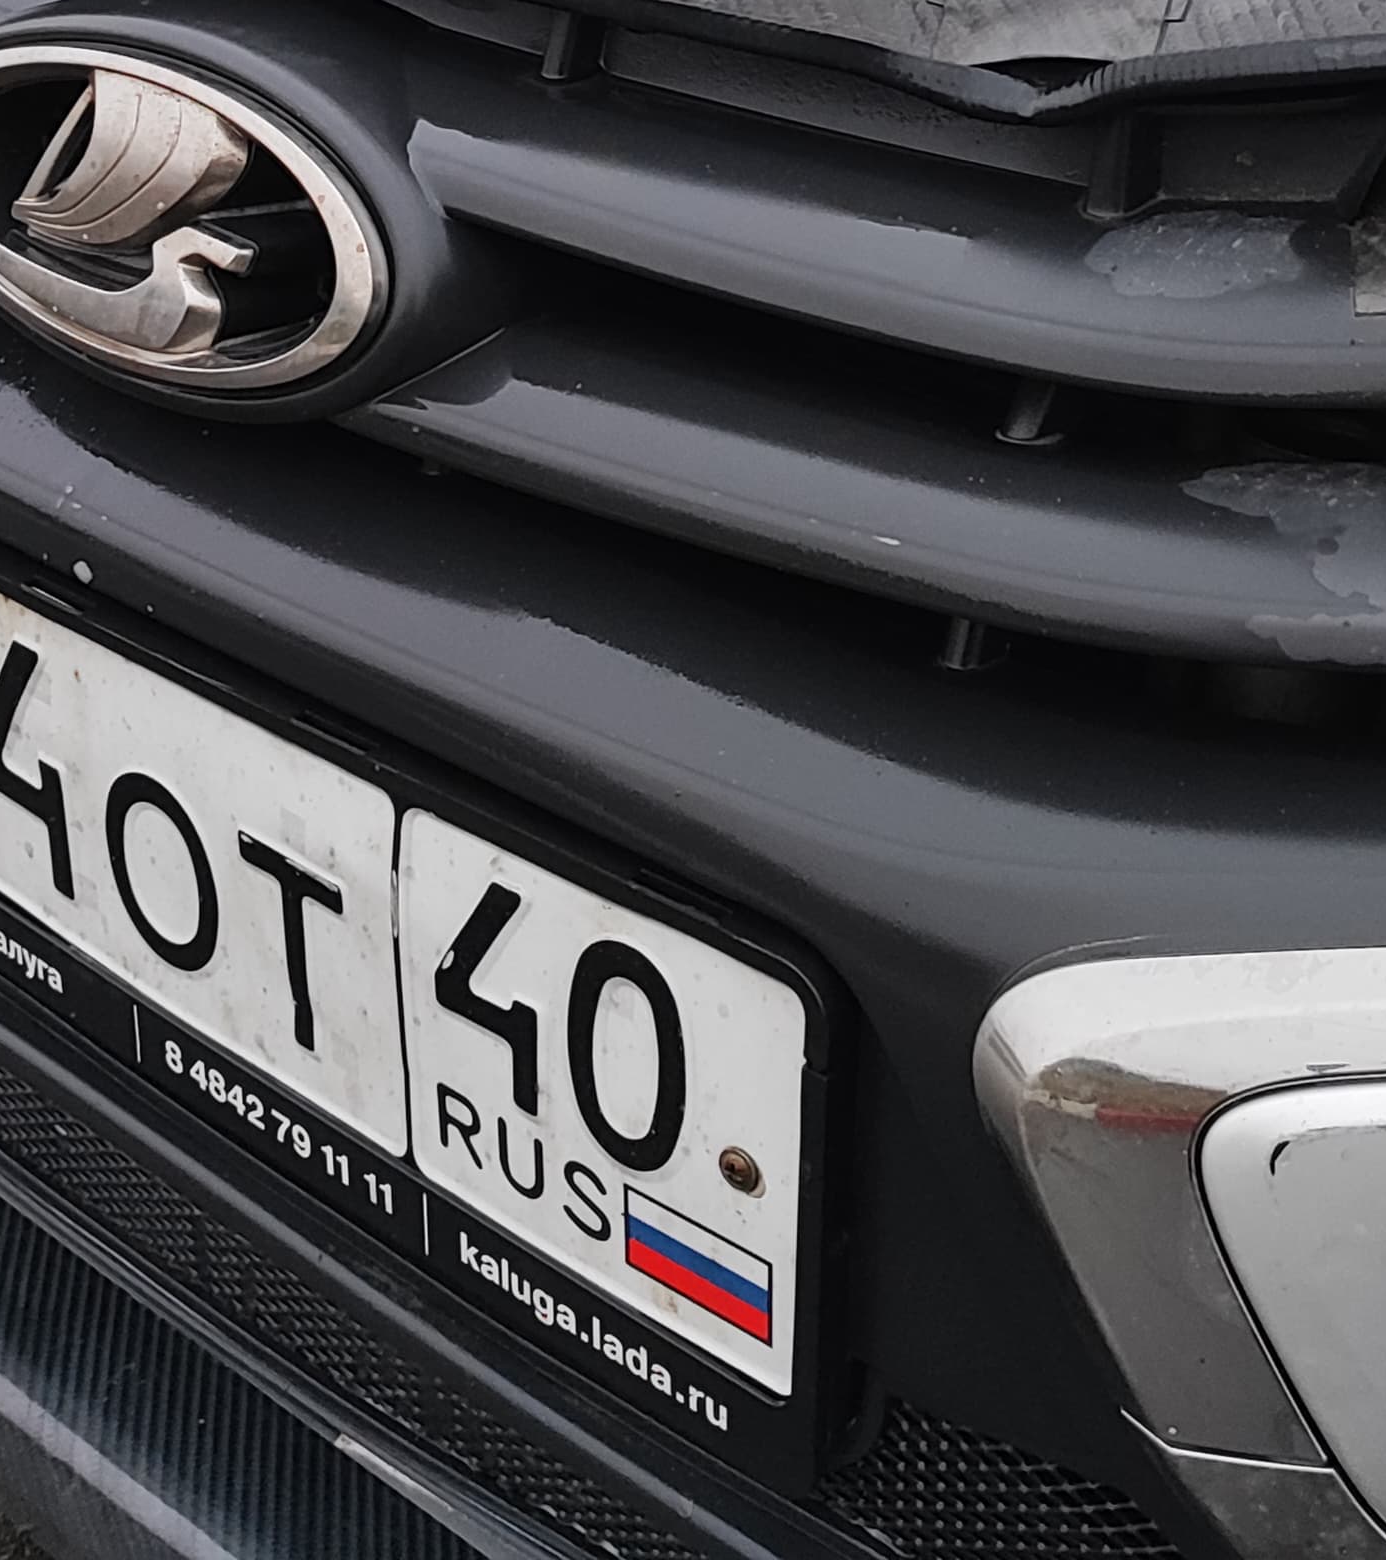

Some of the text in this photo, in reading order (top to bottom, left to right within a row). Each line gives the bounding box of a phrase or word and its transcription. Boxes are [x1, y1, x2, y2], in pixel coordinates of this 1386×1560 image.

[433, 881, 687, 1172] 40
[164, 1040, 395, 1215] 8 4842 79 11 11
[437, 1083, 612, 1242] RUS
[459, 1231, 729, 1431] kaluga.lada.ru
